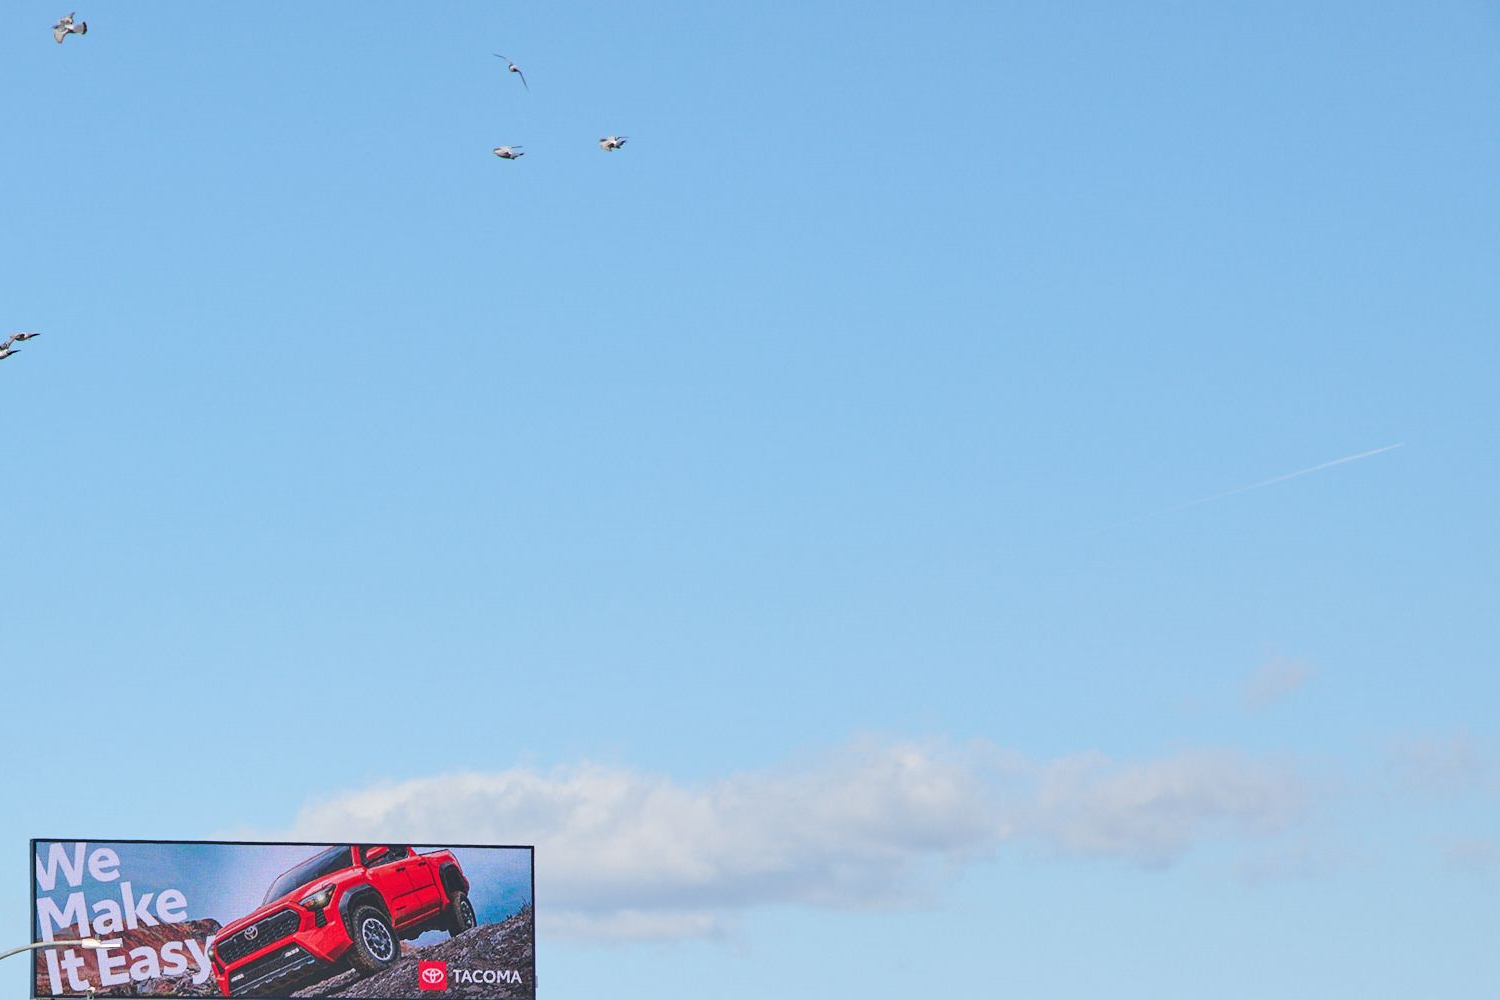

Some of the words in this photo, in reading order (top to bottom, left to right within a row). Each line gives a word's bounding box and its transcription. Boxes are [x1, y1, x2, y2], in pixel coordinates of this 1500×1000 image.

[36, 842, 120, 892] We
[37, 882, 188, 942] Make
[45, 948, 90, 995] It
[96, 935, 217, 986] Easy
[453, 970, 522, 984] TACOMA
